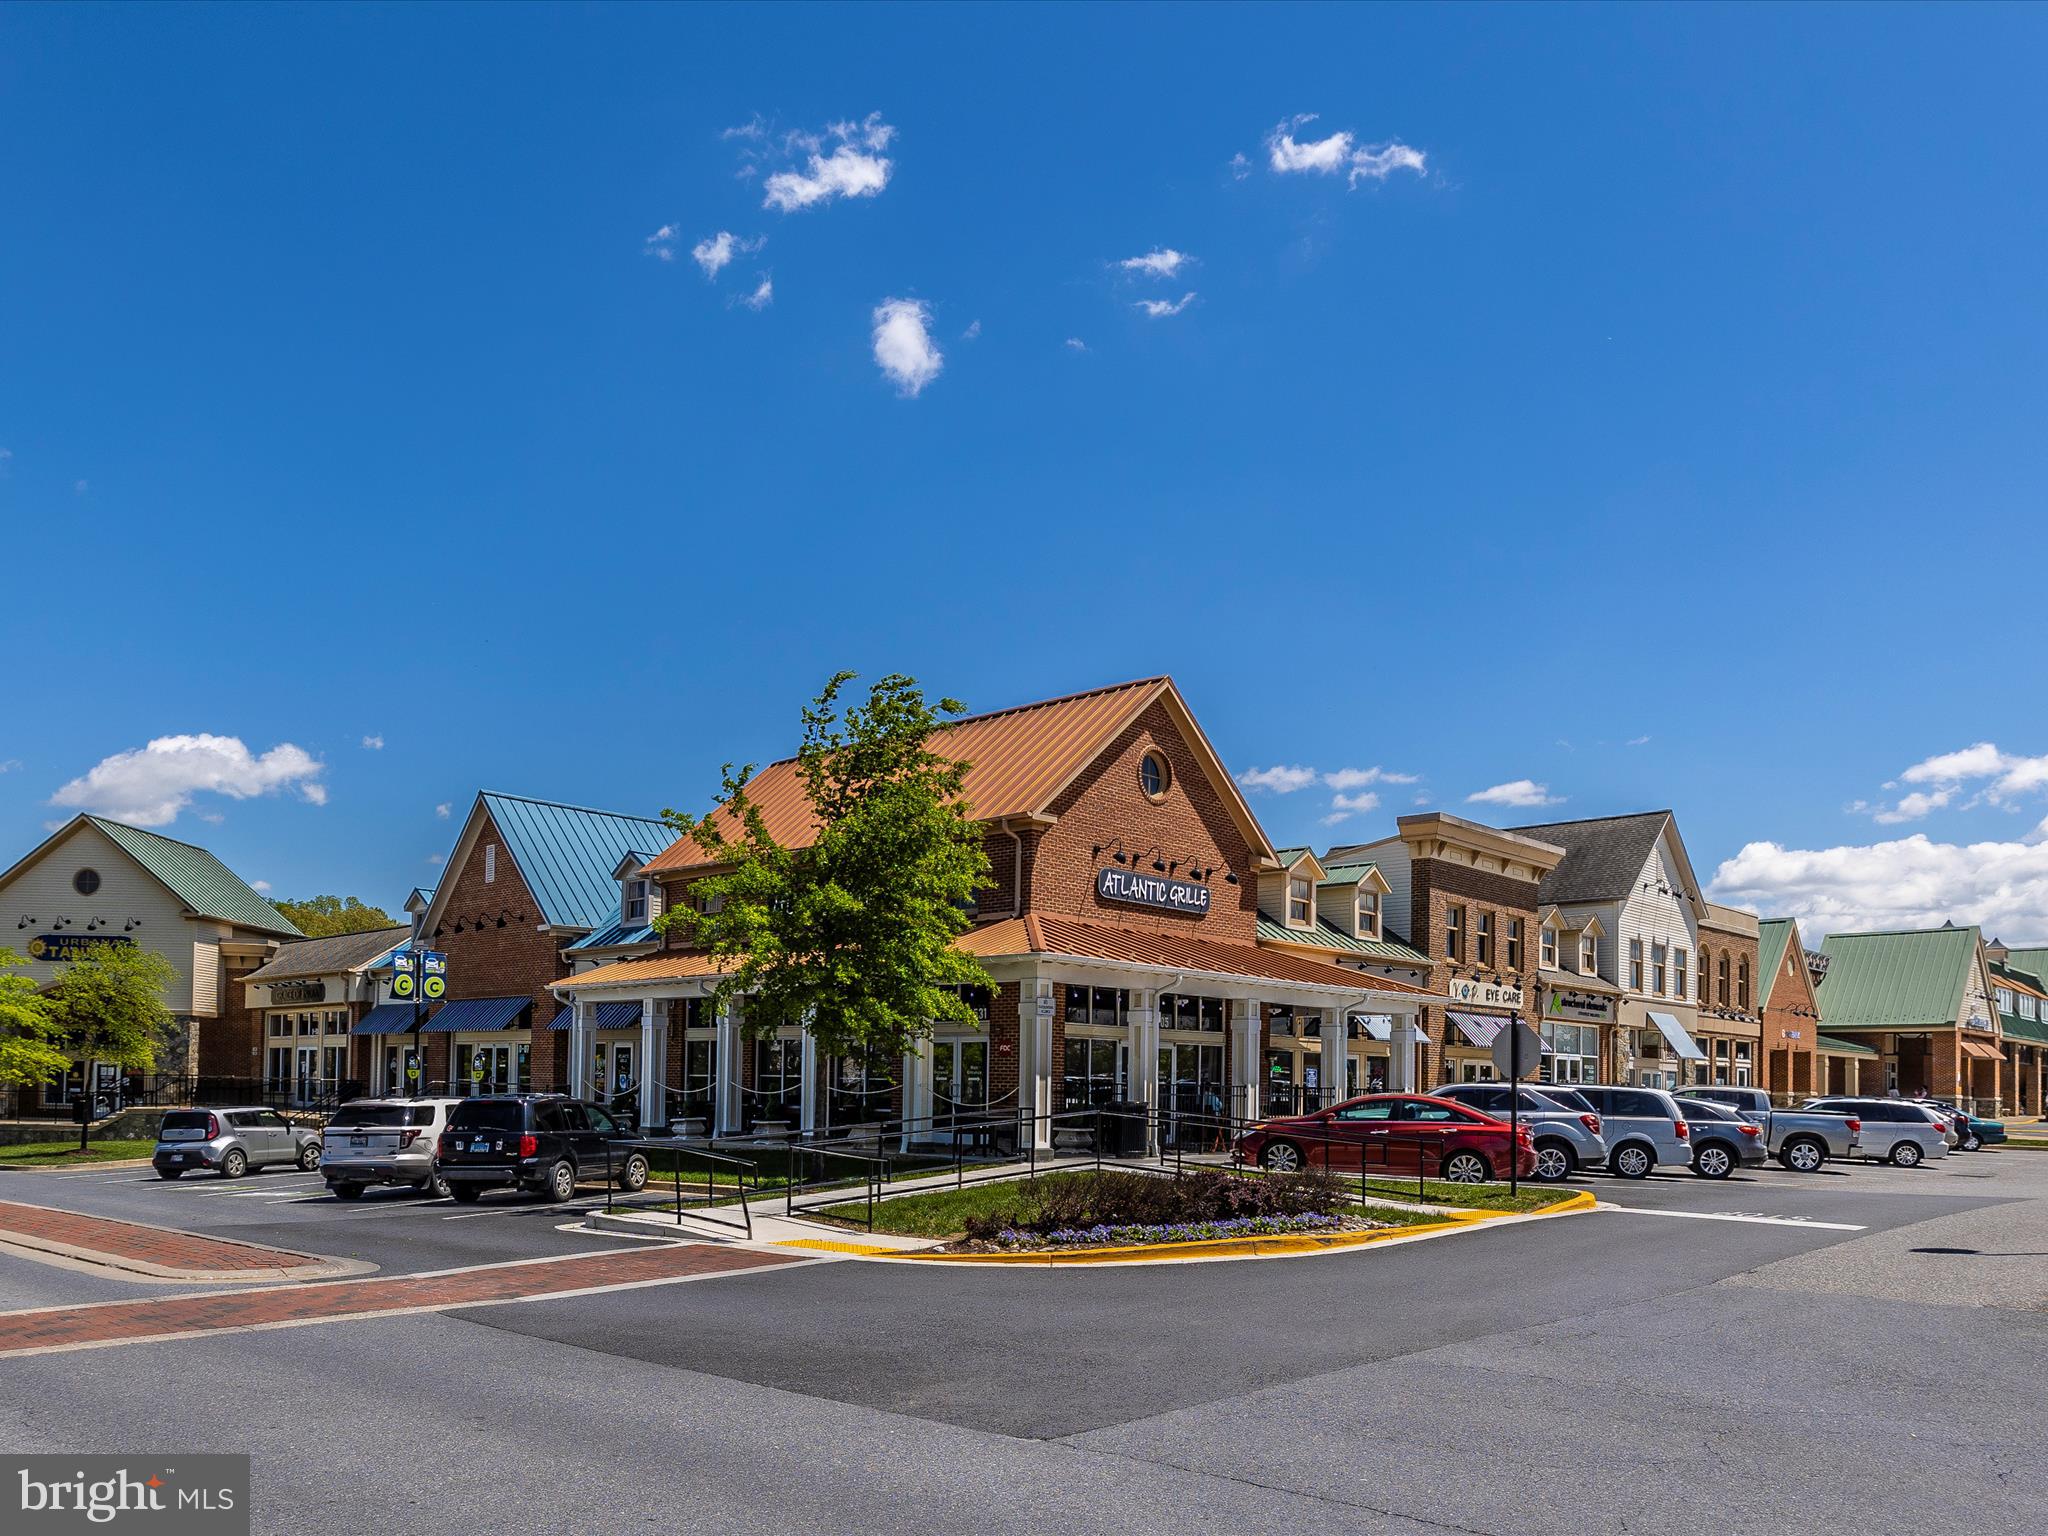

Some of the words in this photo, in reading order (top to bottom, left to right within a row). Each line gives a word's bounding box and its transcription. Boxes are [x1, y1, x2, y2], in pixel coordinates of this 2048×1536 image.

[1103, 871, 1167, 902] ATLANTIC
[1169, 885, 1208, 907] GRILLE
[399, 979, 409, 991] C
[429, 981, 440, 993] C
[1485, 988, 1500, 1003] EYE
[1502, 990, 1522, 1004] CARE
